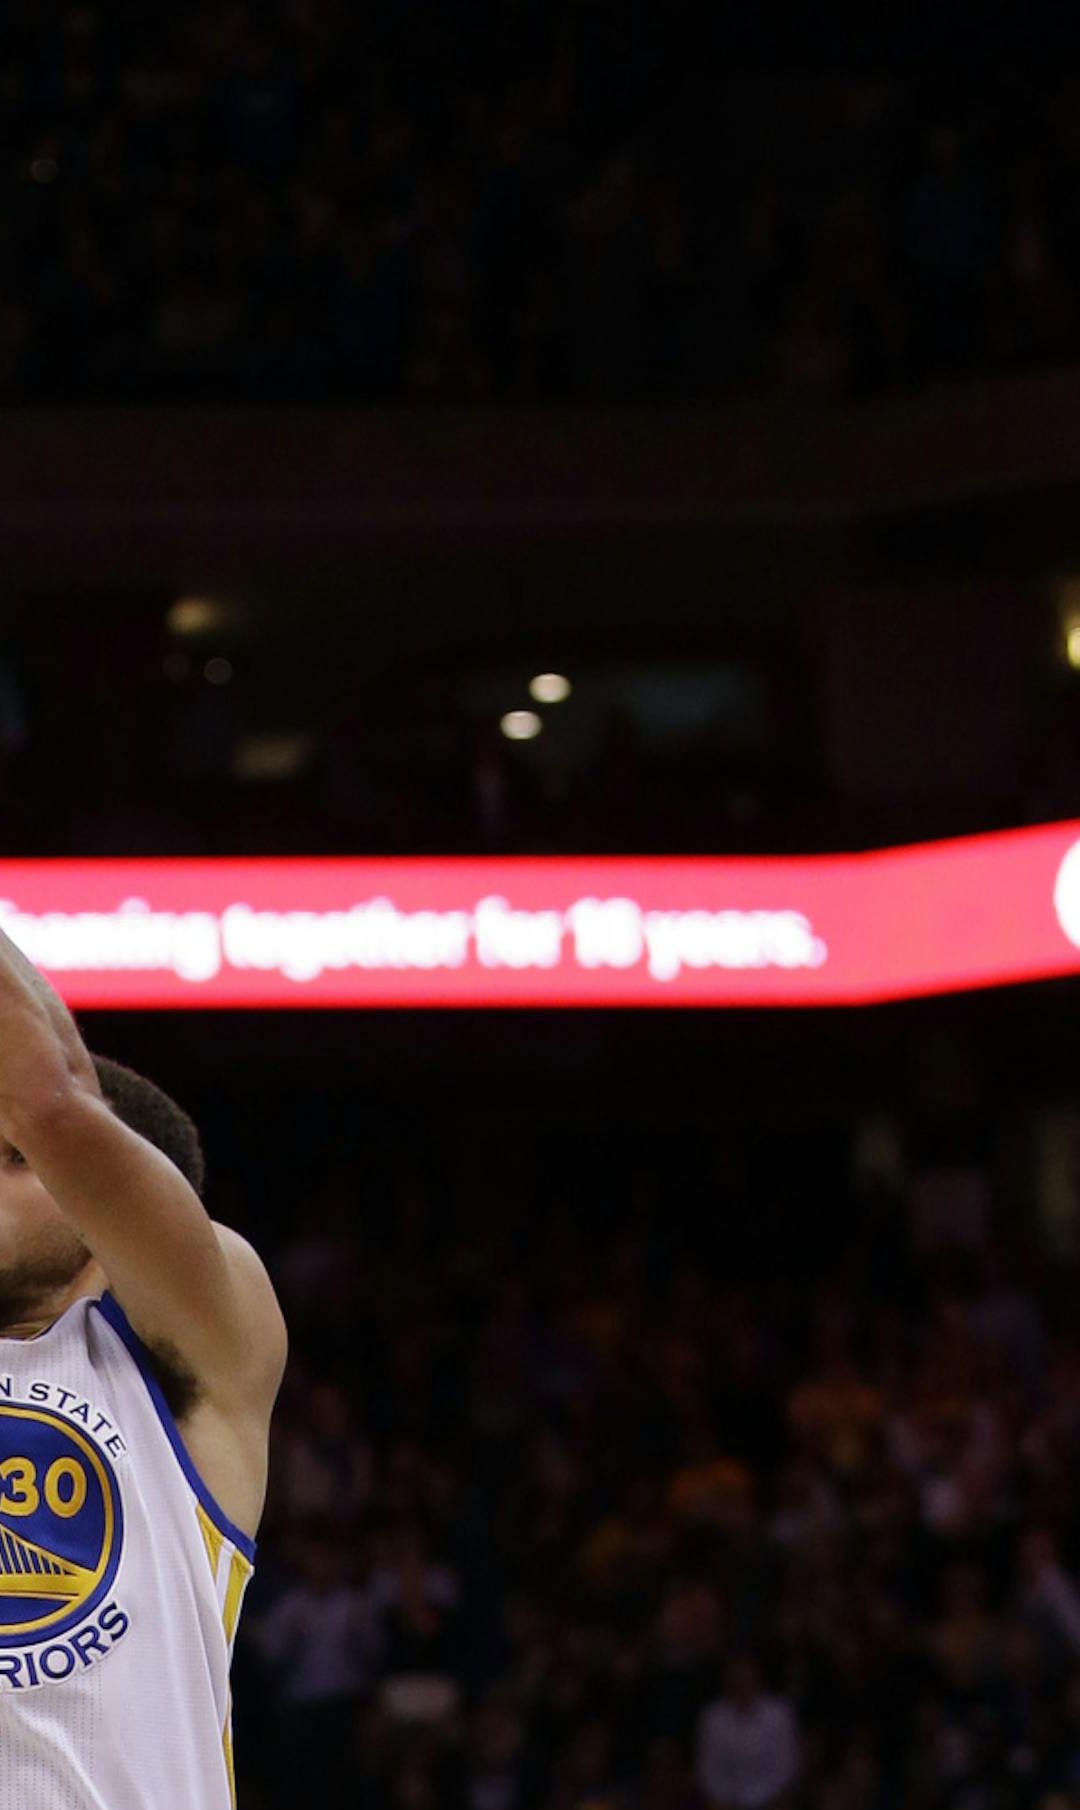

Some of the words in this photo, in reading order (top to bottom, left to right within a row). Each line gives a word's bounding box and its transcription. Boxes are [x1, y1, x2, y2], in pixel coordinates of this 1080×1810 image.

[221, 896, 470, 981] together
[474, 895, 563, 968] for
[567, 896, 644, 968] 10
[28, 1382, 127, 1458] STATE
